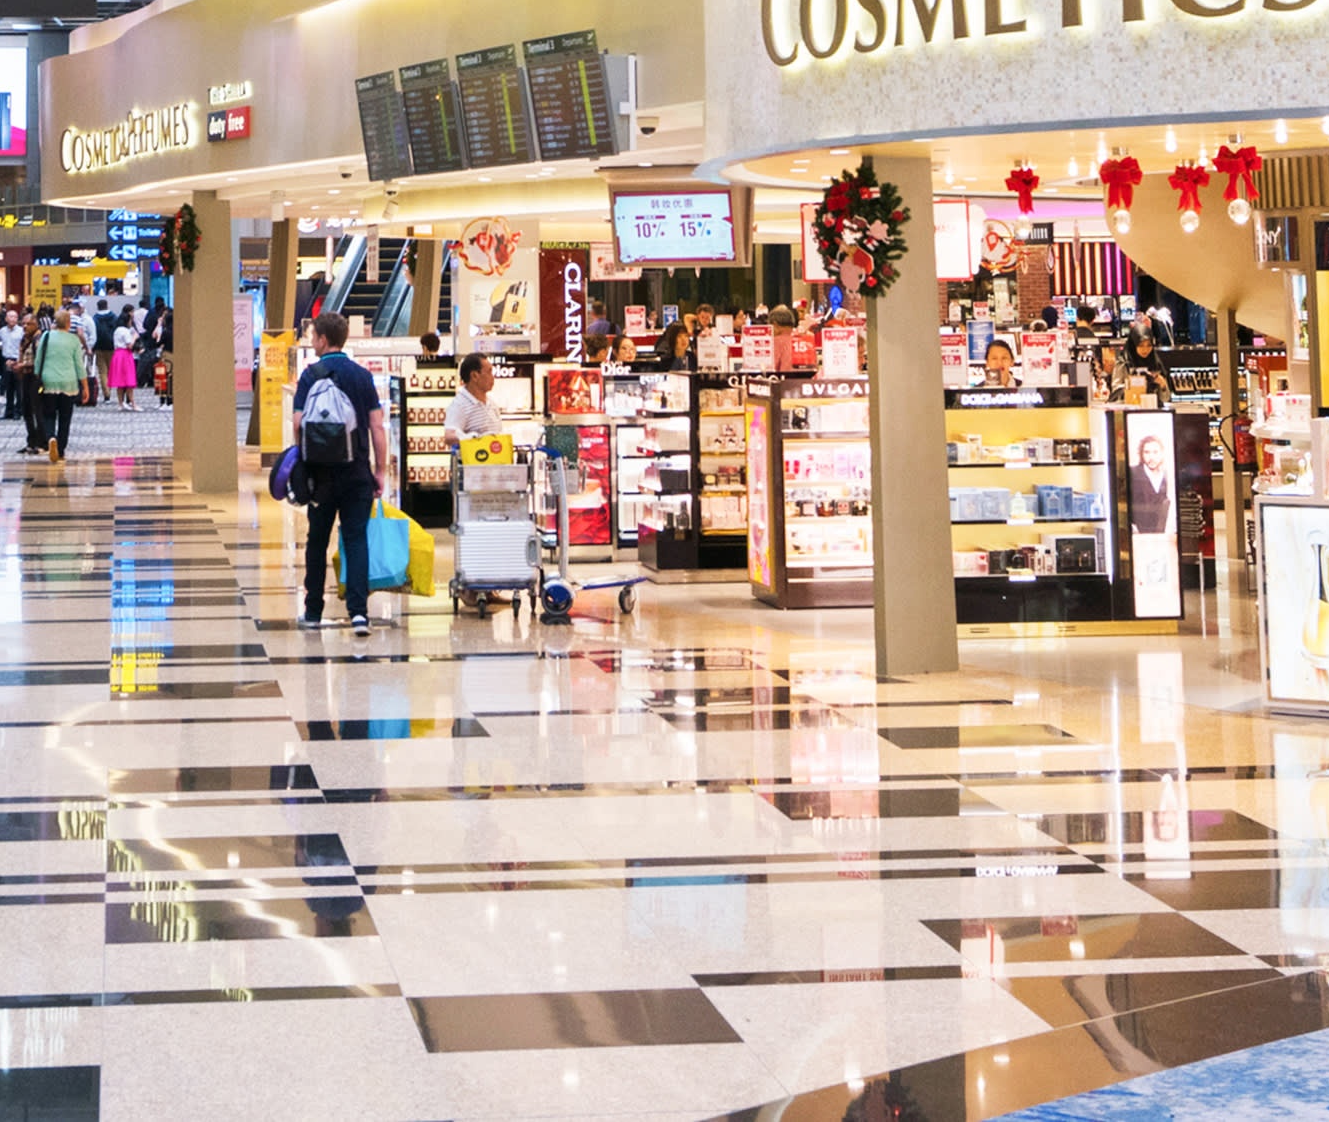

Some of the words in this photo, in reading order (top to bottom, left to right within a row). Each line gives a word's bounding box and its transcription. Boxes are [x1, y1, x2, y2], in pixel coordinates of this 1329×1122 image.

[209, 115, 226, 139] duty
[227, 113, 245, 131] free
[634, 222, 665, 238] 10%
[680, 221, 712, 237] 15%
[564, 262, 583, 365] CLARIN
[801, 382, 870, 396] BVLGA
